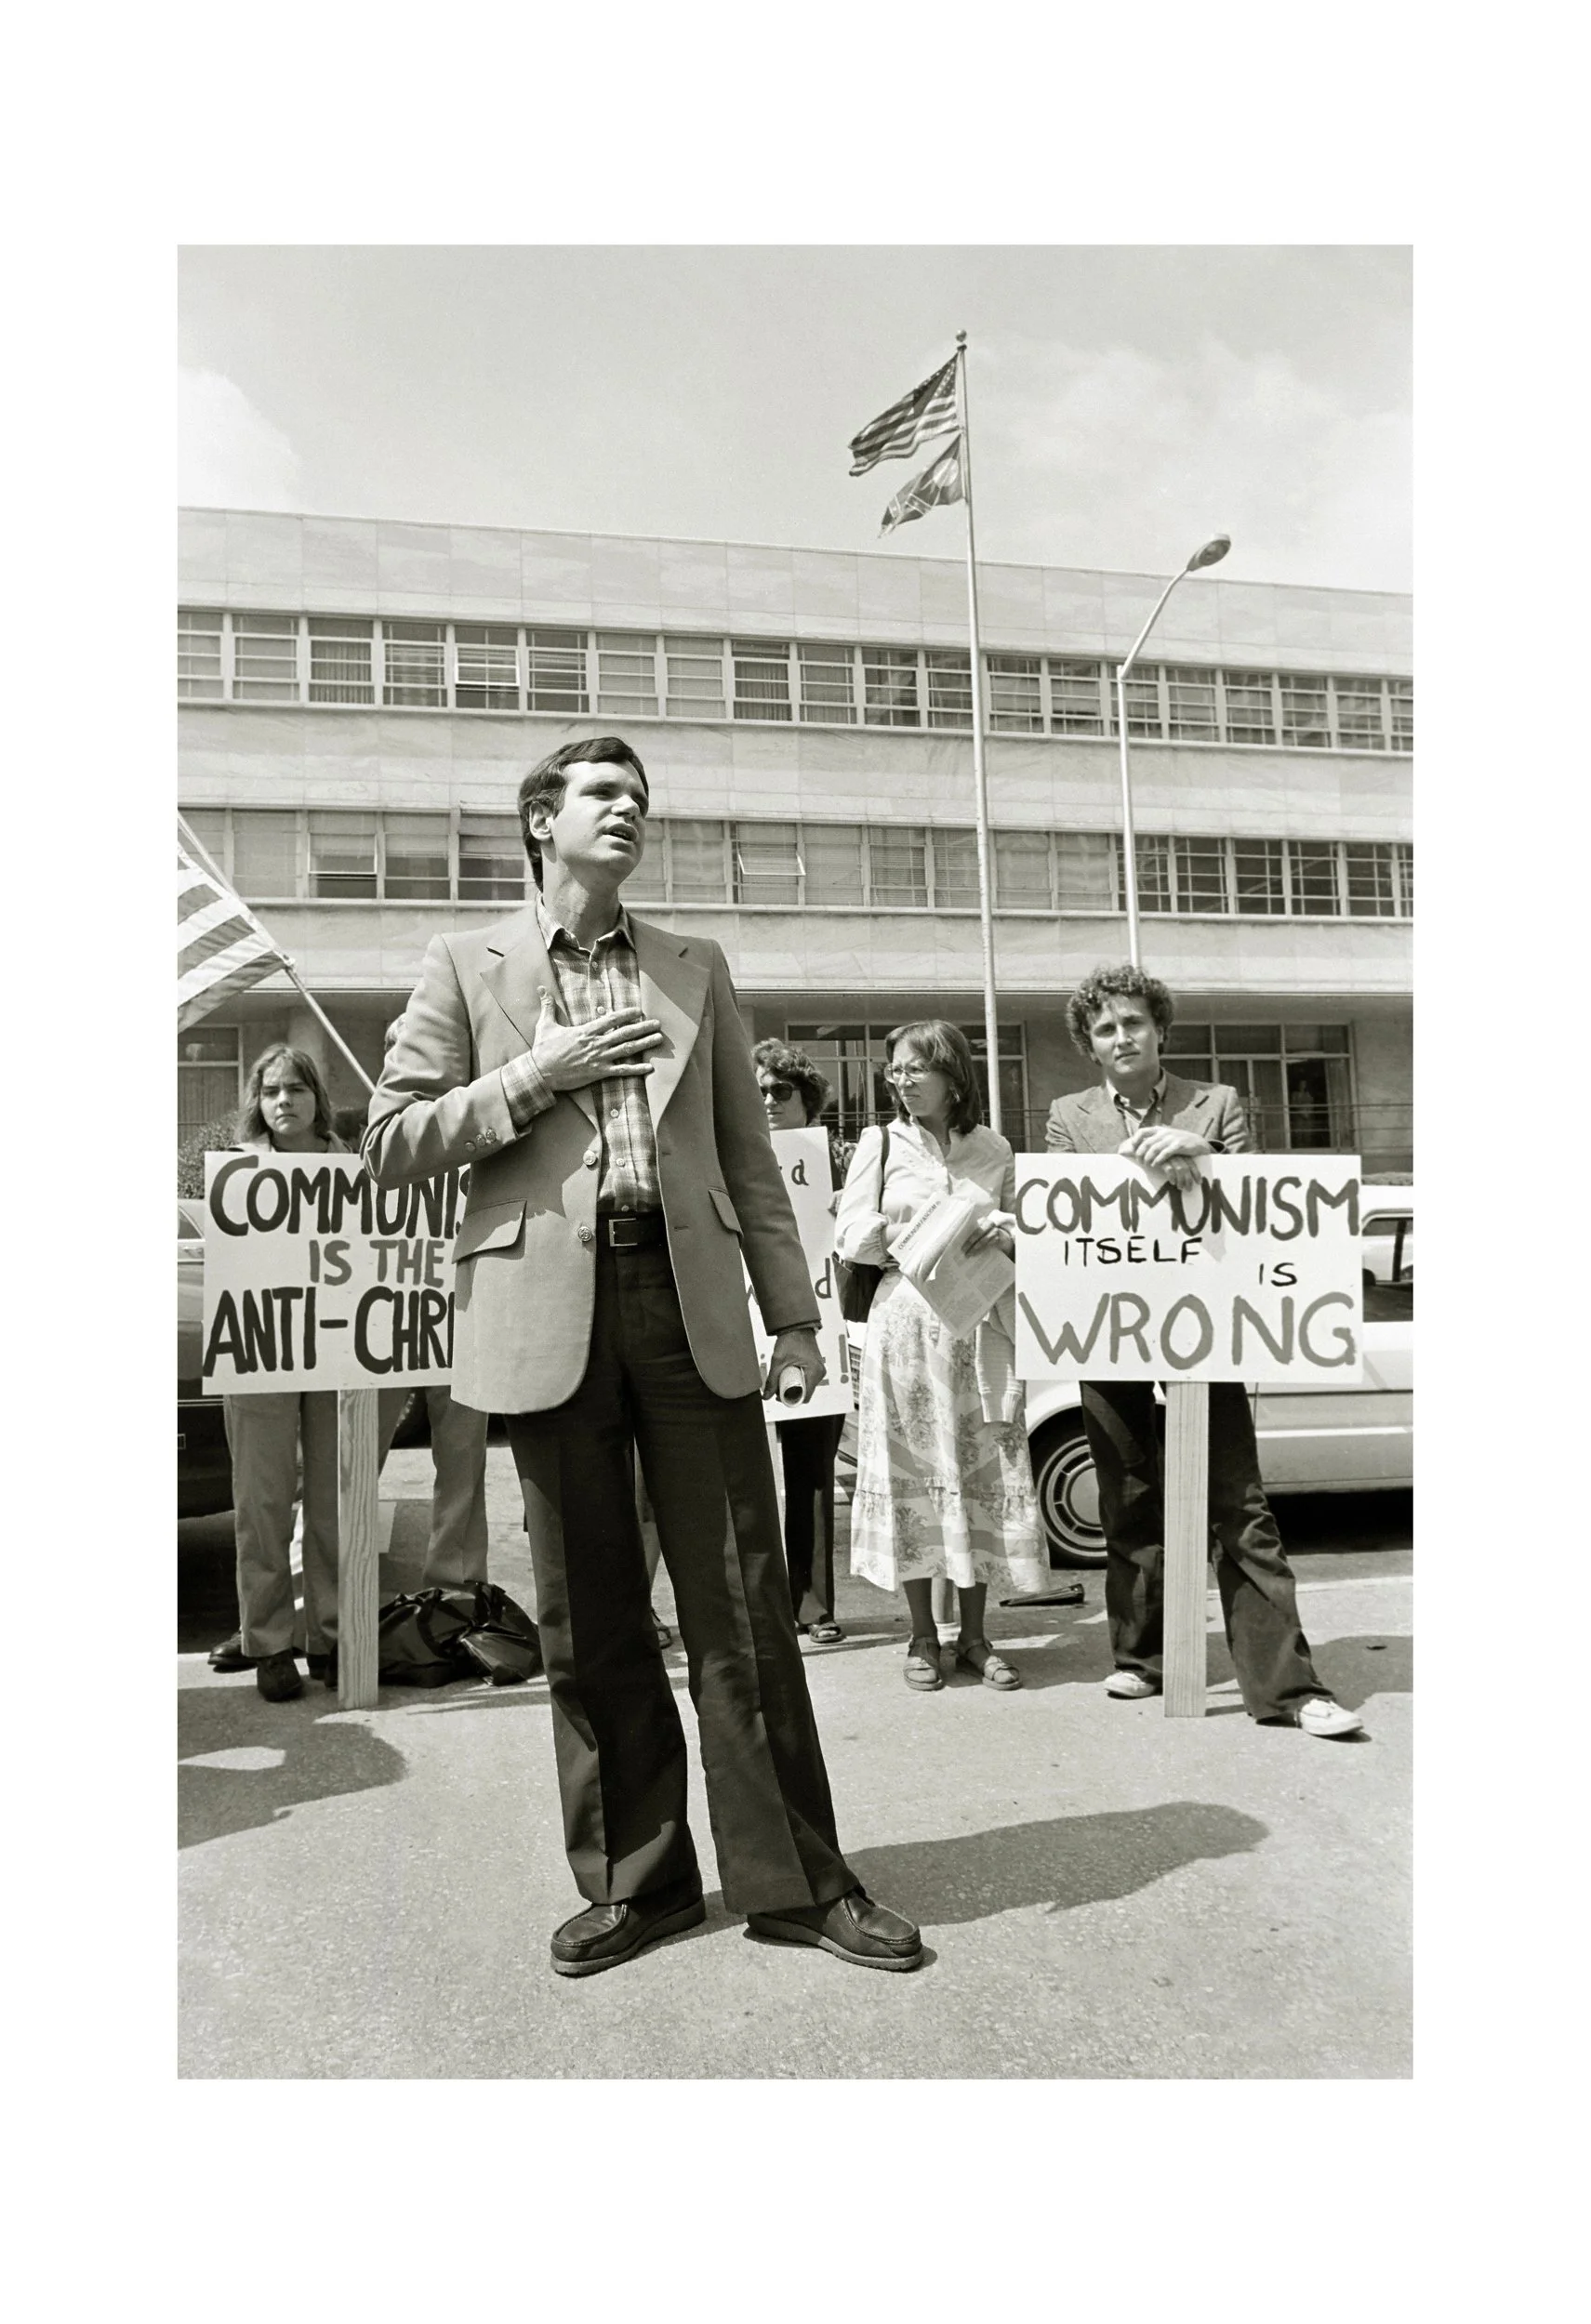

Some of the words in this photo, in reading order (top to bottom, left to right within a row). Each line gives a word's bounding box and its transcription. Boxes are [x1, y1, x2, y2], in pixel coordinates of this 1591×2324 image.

[1015, 1176, 1359, 1241] COMMUNISM
[309, 1240, 351, 1286] IS
[369, 1238, 444, 1287] THE
[1065, 1236, 1202, 1267] ITSELF
[1258, 1262, 1298, 1287] IS
[1018, 1292, 1357, 1371] WRONG
